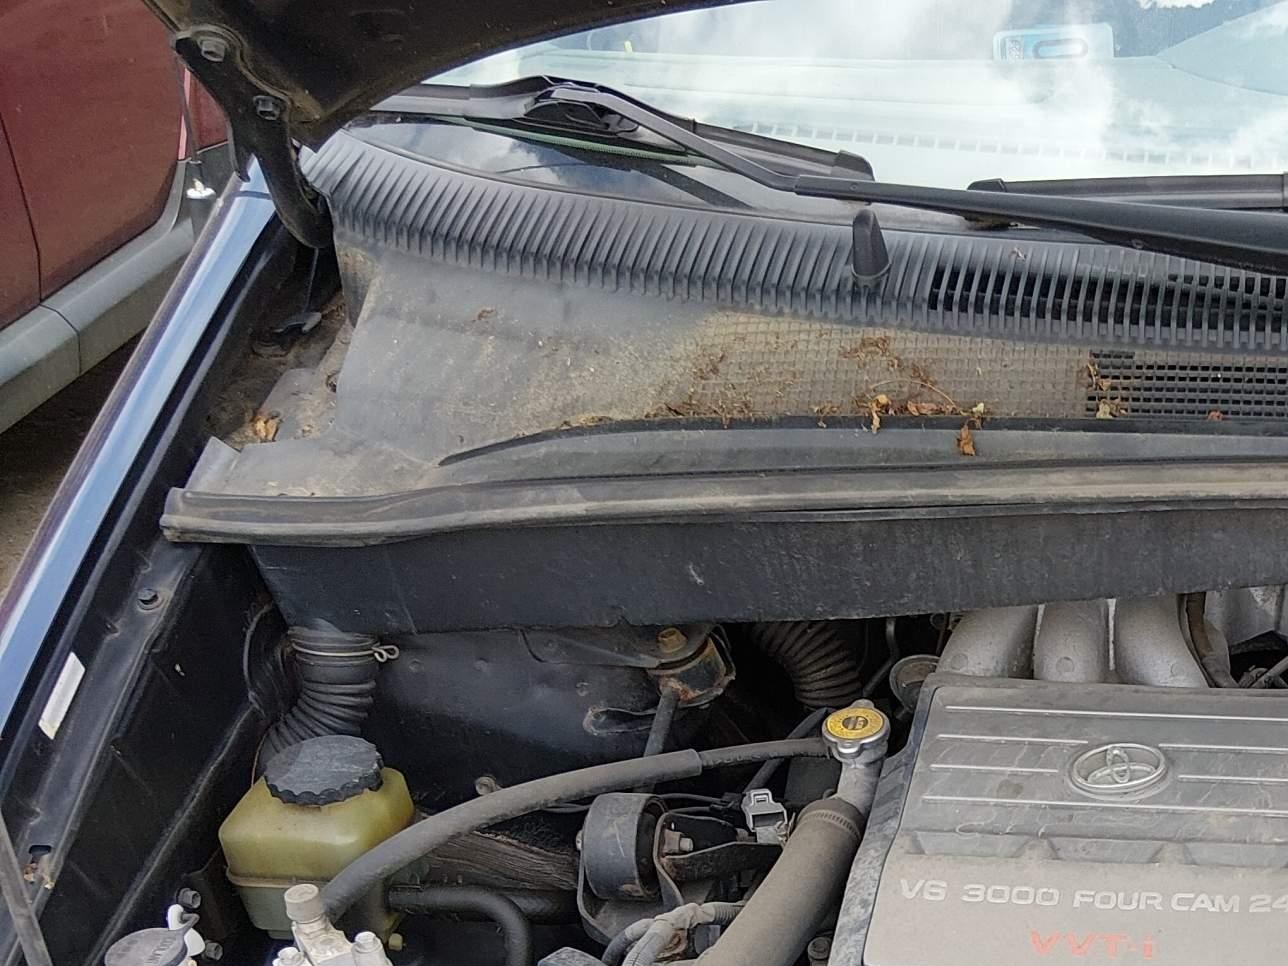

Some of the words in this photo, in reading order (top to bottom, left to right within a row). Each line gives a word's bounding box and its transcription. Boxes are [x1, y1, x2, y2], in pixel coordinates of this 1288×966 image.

[899, 879, 948, 900] V6
[961, 884, 1061, 906] 3000
[1073, 889, 1164, 912] FOUR
[1170, 892, 1240, 914] CAM
[1030, 928, 1155, 960] VVT-i
